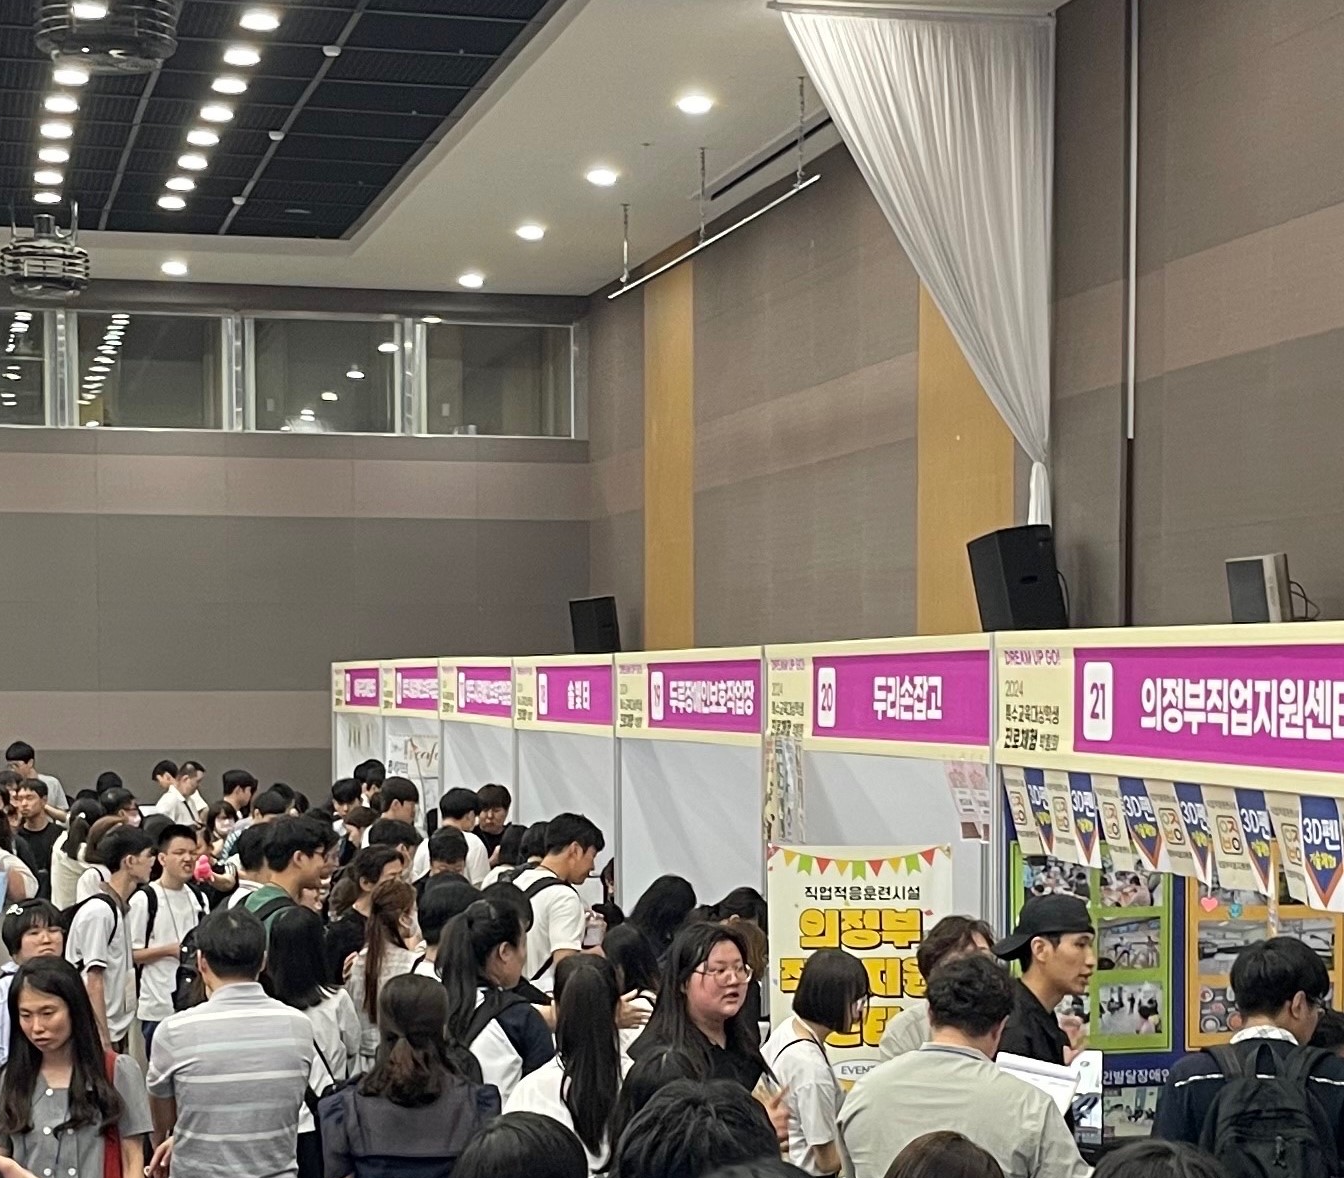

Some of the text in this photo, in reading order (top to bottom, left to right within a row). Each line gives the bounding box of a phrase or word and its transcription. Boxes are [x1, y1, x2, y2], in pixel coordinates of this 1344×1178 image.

[821, 683, 834, 712] 20
[1090, 681, 1106, 721] 21
[1302, 817, 1341, 851] 3D펜
[804, 886, 920, 901] 직업적응훈련시설
[799, 908, 924, 950] 의정부
